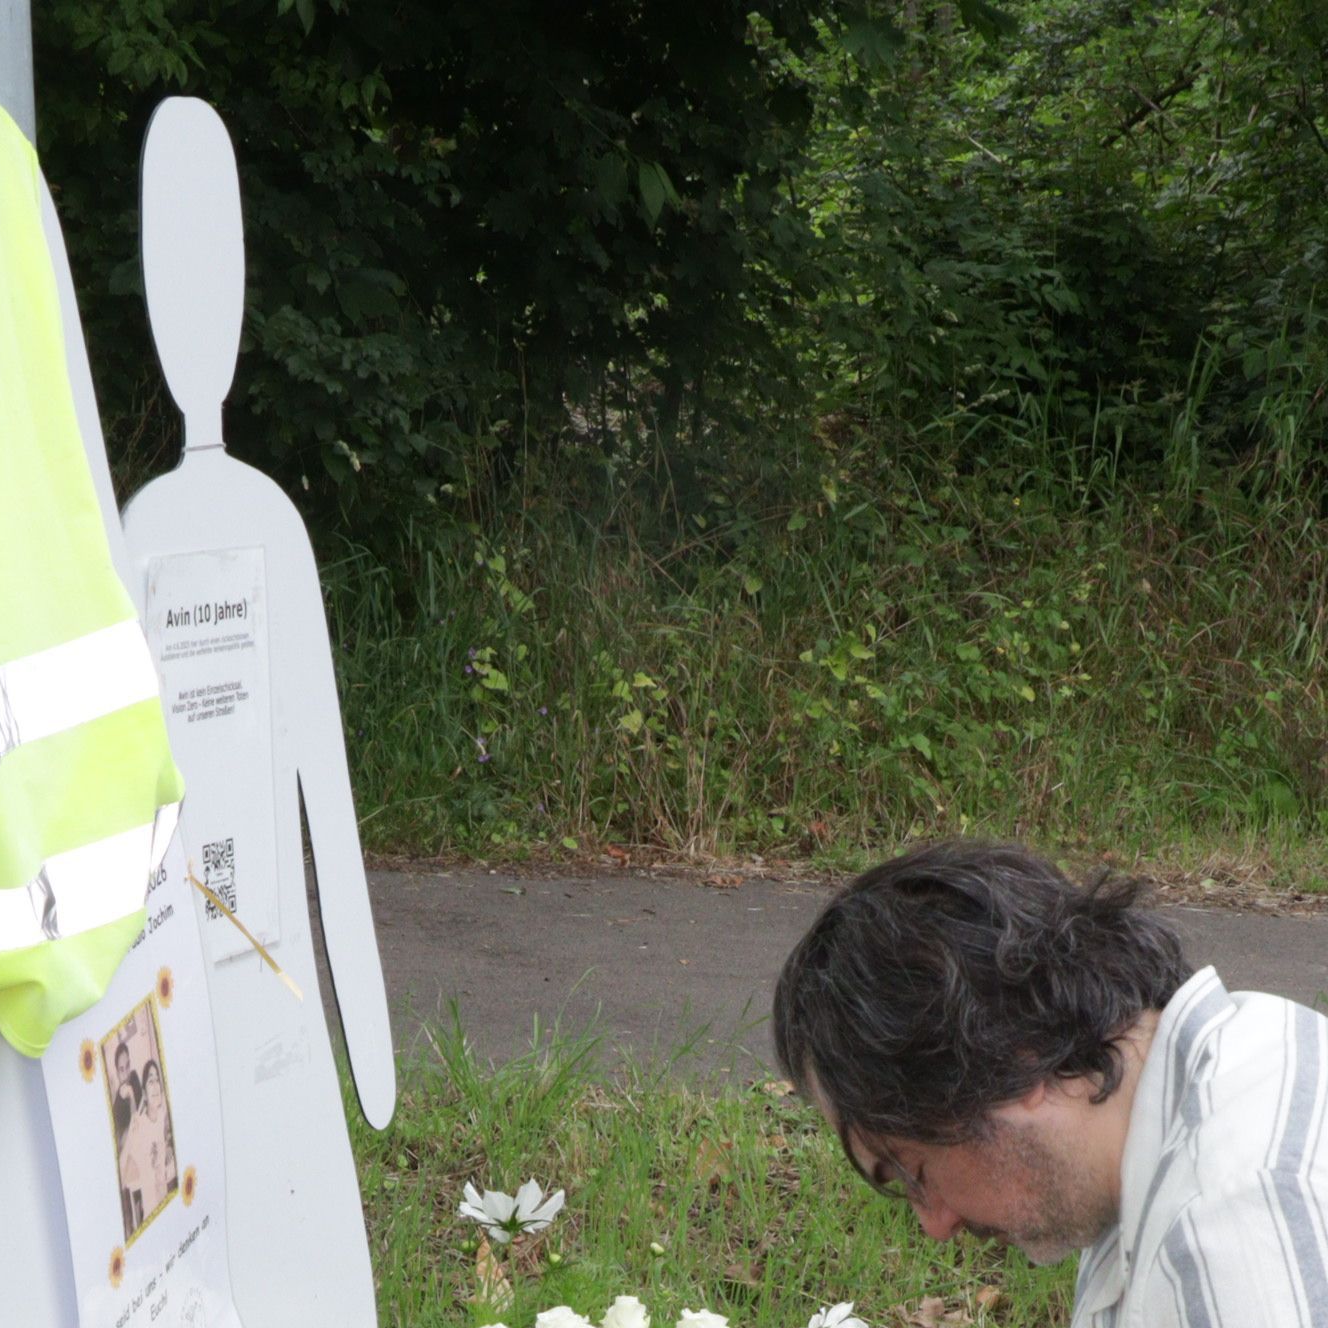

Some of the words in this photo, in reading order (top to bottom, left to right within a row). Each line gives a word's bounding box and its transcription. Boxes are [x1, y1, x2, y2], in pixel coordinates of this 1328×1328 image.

[166, 606, 191, 629] Avin
[193, 603, 211, 627] (10
[213, 597, 248, 626] Jahre)
[147, 903, 175, 935] Jochim
[132, 1288, 144, 1314] bei
[145, 1276, 158, 1298] uns
[165, 1254, 177, 1274] wir
[177, 1226, 201, 1259] denken
[201, 1214, 210, 1231] an
